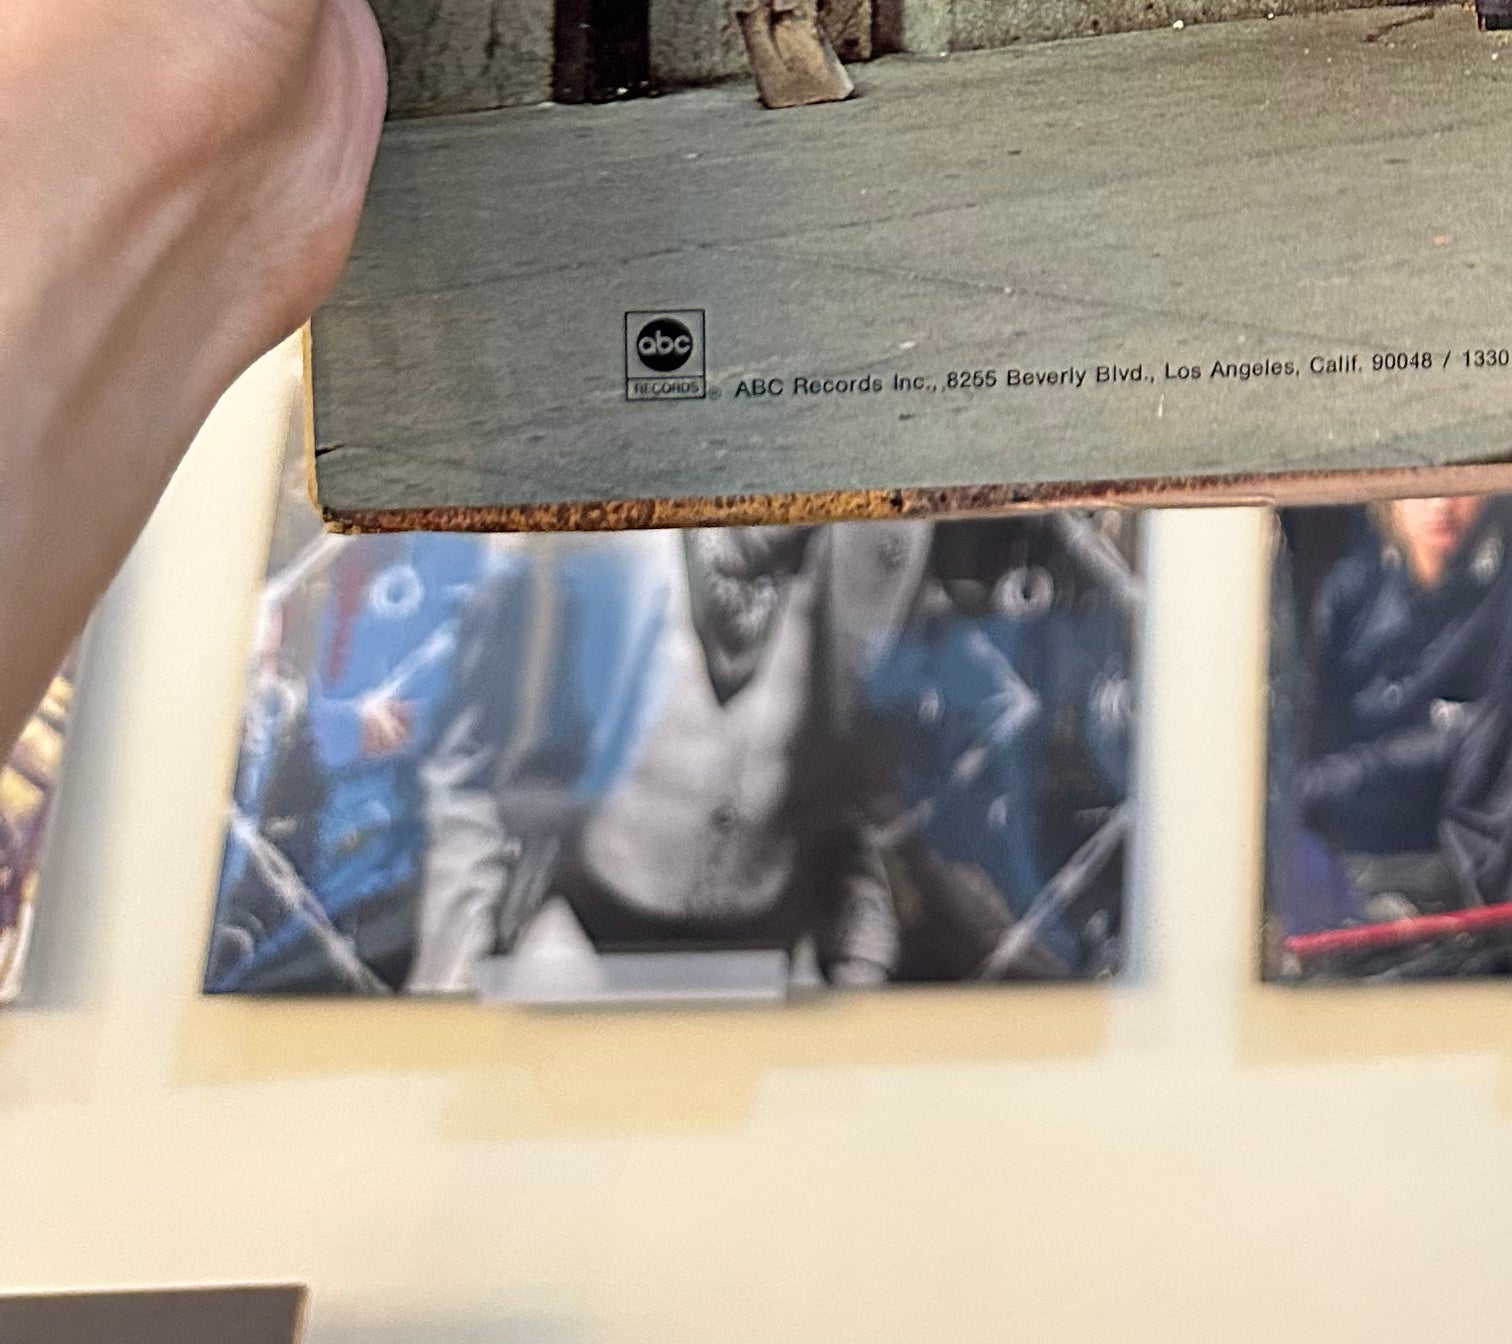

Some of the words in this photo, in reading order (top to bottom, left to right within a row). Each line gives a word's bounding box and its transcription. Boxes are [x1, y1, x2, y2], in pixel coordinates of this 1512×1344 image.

[639, 330, 691, 355] abc
[734, 377, 784, 399] ABC
[792, 374, 883, 396] Records
[1006, 365, 1087, 389] Beverly
[1095, 363, 1156, 386] Blvd.,
[1164, 361, 1202, 381] Los
[1209, 358, 1300, 383] Angeles,
[1309, 354, 1362, 376] Calif.
[1371, 351, 1433, 372] 90048
[1462, 348, 1510, 368] 1330
